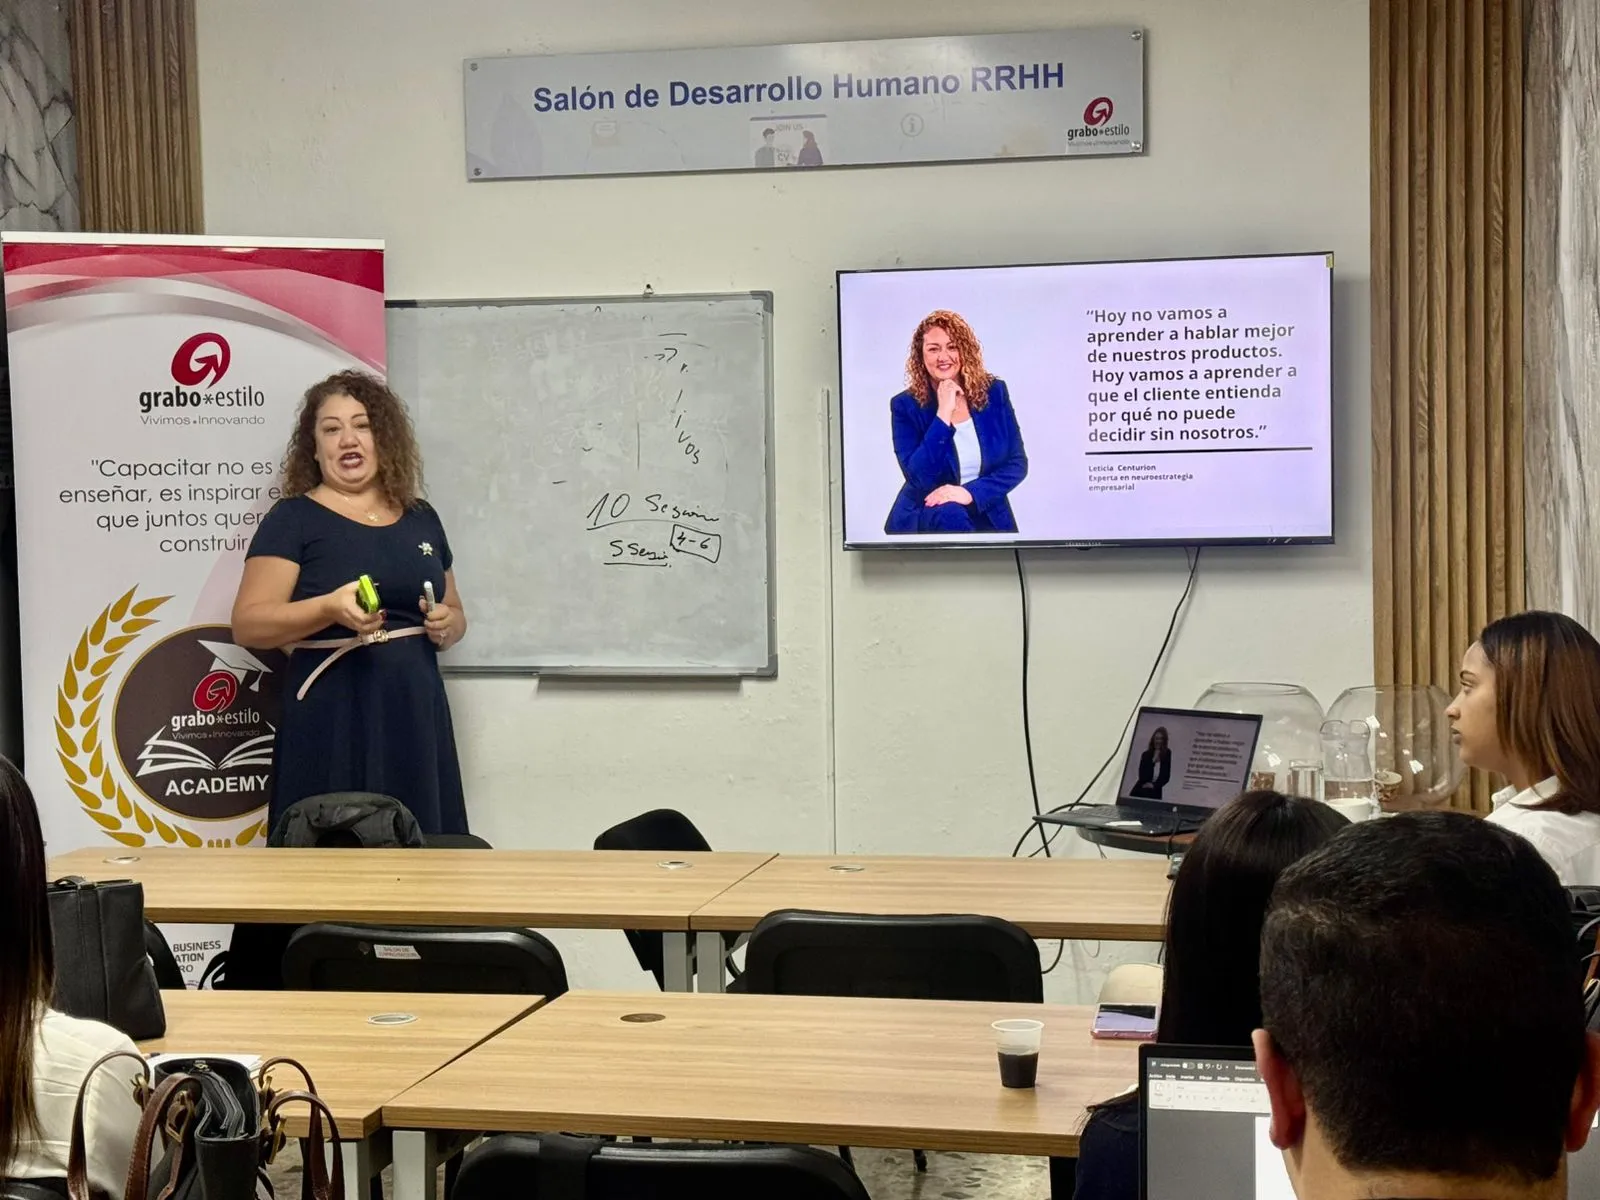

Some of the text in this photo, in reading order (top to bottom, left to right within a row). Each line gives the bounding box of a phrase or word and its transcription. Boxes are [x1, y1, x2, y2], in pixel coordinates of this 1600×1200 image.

[533, 62, 1064, 112] Salón de Desarrollo Humano RRHH
[1086, 308, 1227, 326] “Hoy no vamos a
[1087, 323, 1295, 347] aprender a hablar mejor
[1087, 345, 1282, 364] de nuestros productos.
[1092, 364, 1297, 386] Hoy vamos a aprender a
[1088, 384, 1281, 406] que el cliente entienda
[1088, 405, 1235, 427] por qué no puede
[1088, 425, 1267, 442] decidir sin nosotros.”
[91, 458, 211, 480] "Capacitar
[217, 462, 244, 476] no
[251, 461, 273, 475] es
[1088, 464, 1114, 472] Leticia
[1088, 474, 1118, 483] Experta
[1131, 473, 1193, 481] neuroestrategia
[59, 485, 152, 503] enseñar,
[159, 487, 182, 502] es
[188, 483, 262, 504] inspirar
[1088, 483, 1135, 492] empresarial
[586, 492, 630, 526] 10
[96, 510, 266, 532] que juntos quer
[159, 535, 248, 552] construir
[165, 774, 270, 796] ACADEMY
[173, 940, 222, 952] BUSINESS
